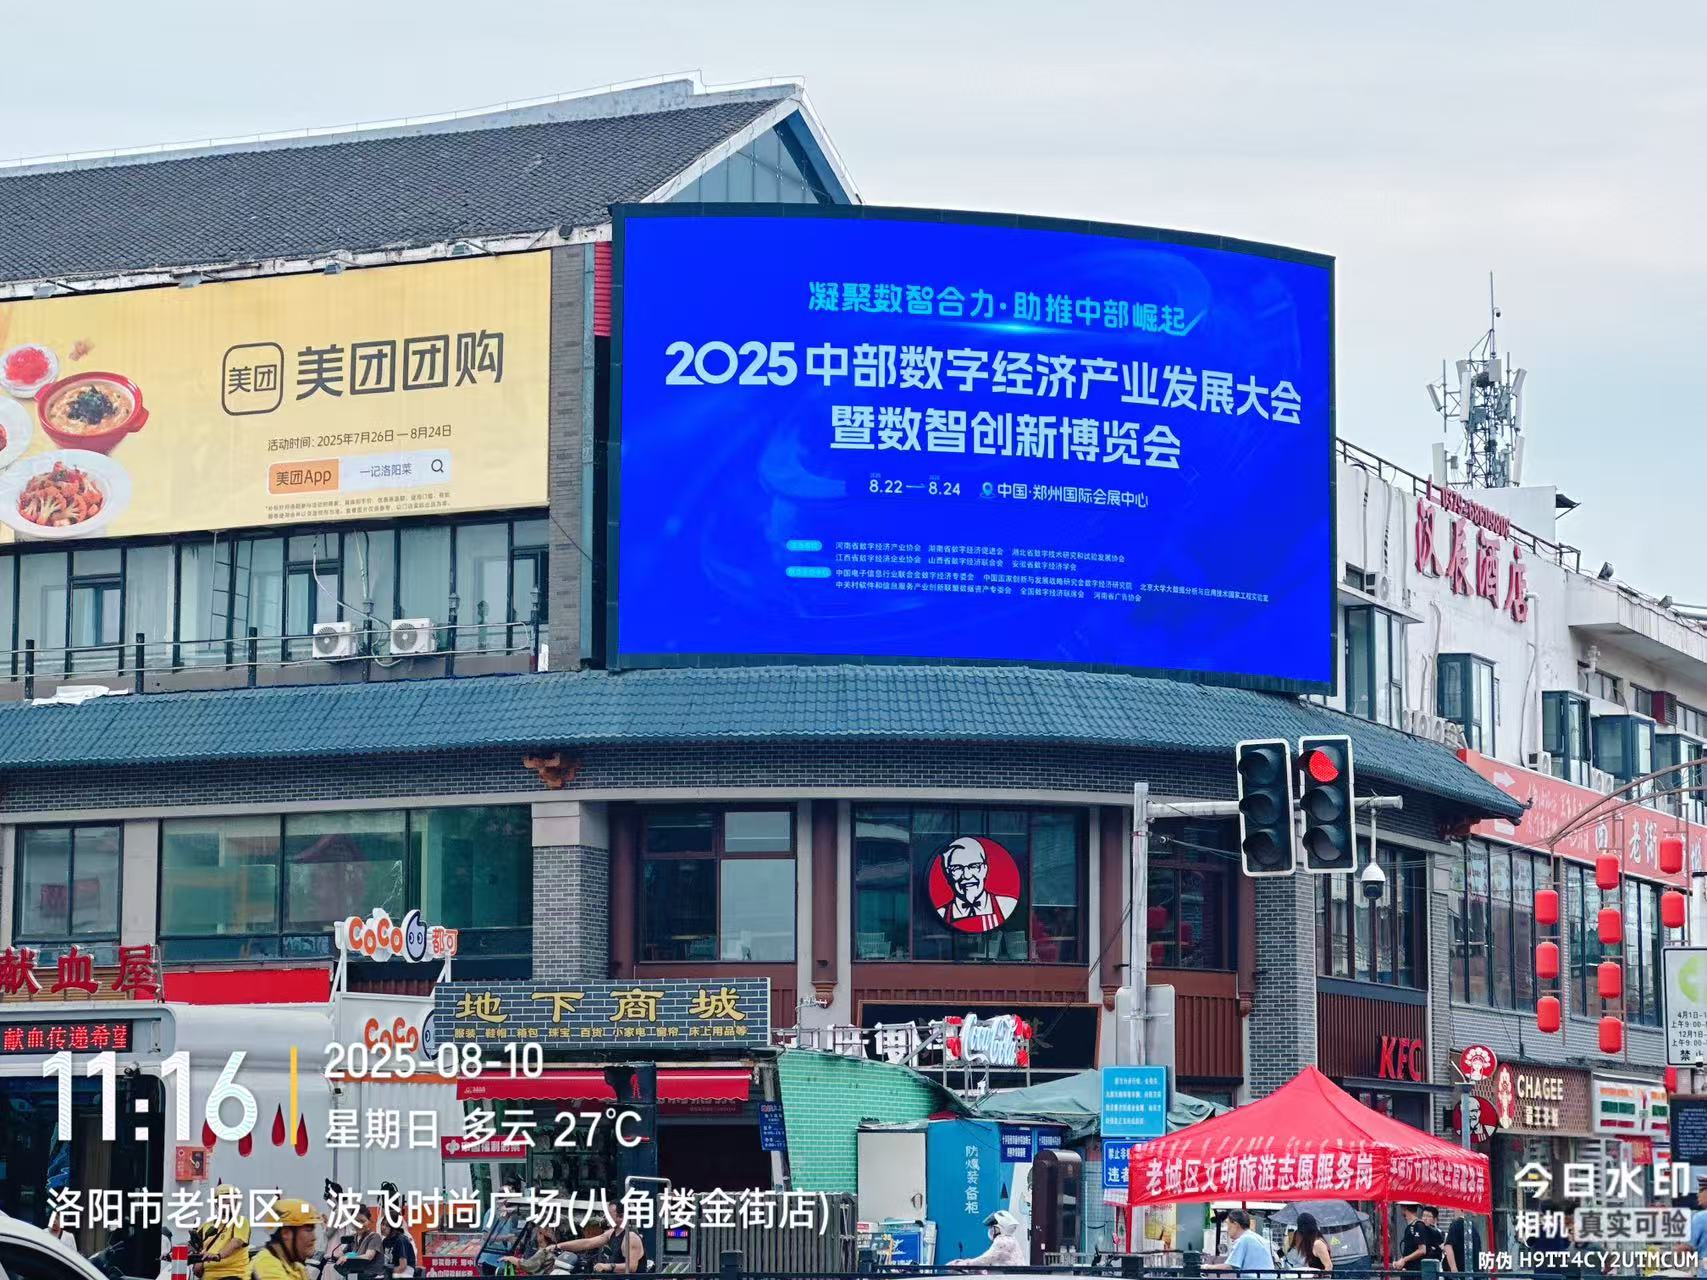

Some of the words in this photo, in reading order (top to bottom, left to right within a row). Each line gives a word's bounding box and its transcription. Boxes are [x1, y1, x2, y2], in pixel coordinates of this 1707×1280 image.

[808, 281, 1187, 336] 凝聚数智合力·助推中部崛起
[228, 364, 277, 395] 美团
[295, 329, 504, 401] 美团团购
[830, 404, 1181, 469] 暨数智创新博览会
[276, 469, 332, 487] 美团App
[359, 462, 412, 478] 一记洛阳菜
[432, 927, 459, 957] 都可
[0, 943, 161, 995] 献血屋
[454, 986, 746, 1024] 地下商城
[3, 1023, 128, 1050] 献血传递希望
[548, 1027, 570, 1038] 珠宝
[580, 1027, 604, 1038] 百货
[613, 1026, 647, 1037] 小家电
[1379, 1035, 1422, 1083] KFC
[1517, 1074, 1563, 1100] CHAGEE
[965, 1145, 980, 1214] 防爆装备柜
[1146, 1152, 1373, 1197] 老城区文明旅游志愿服务岗
